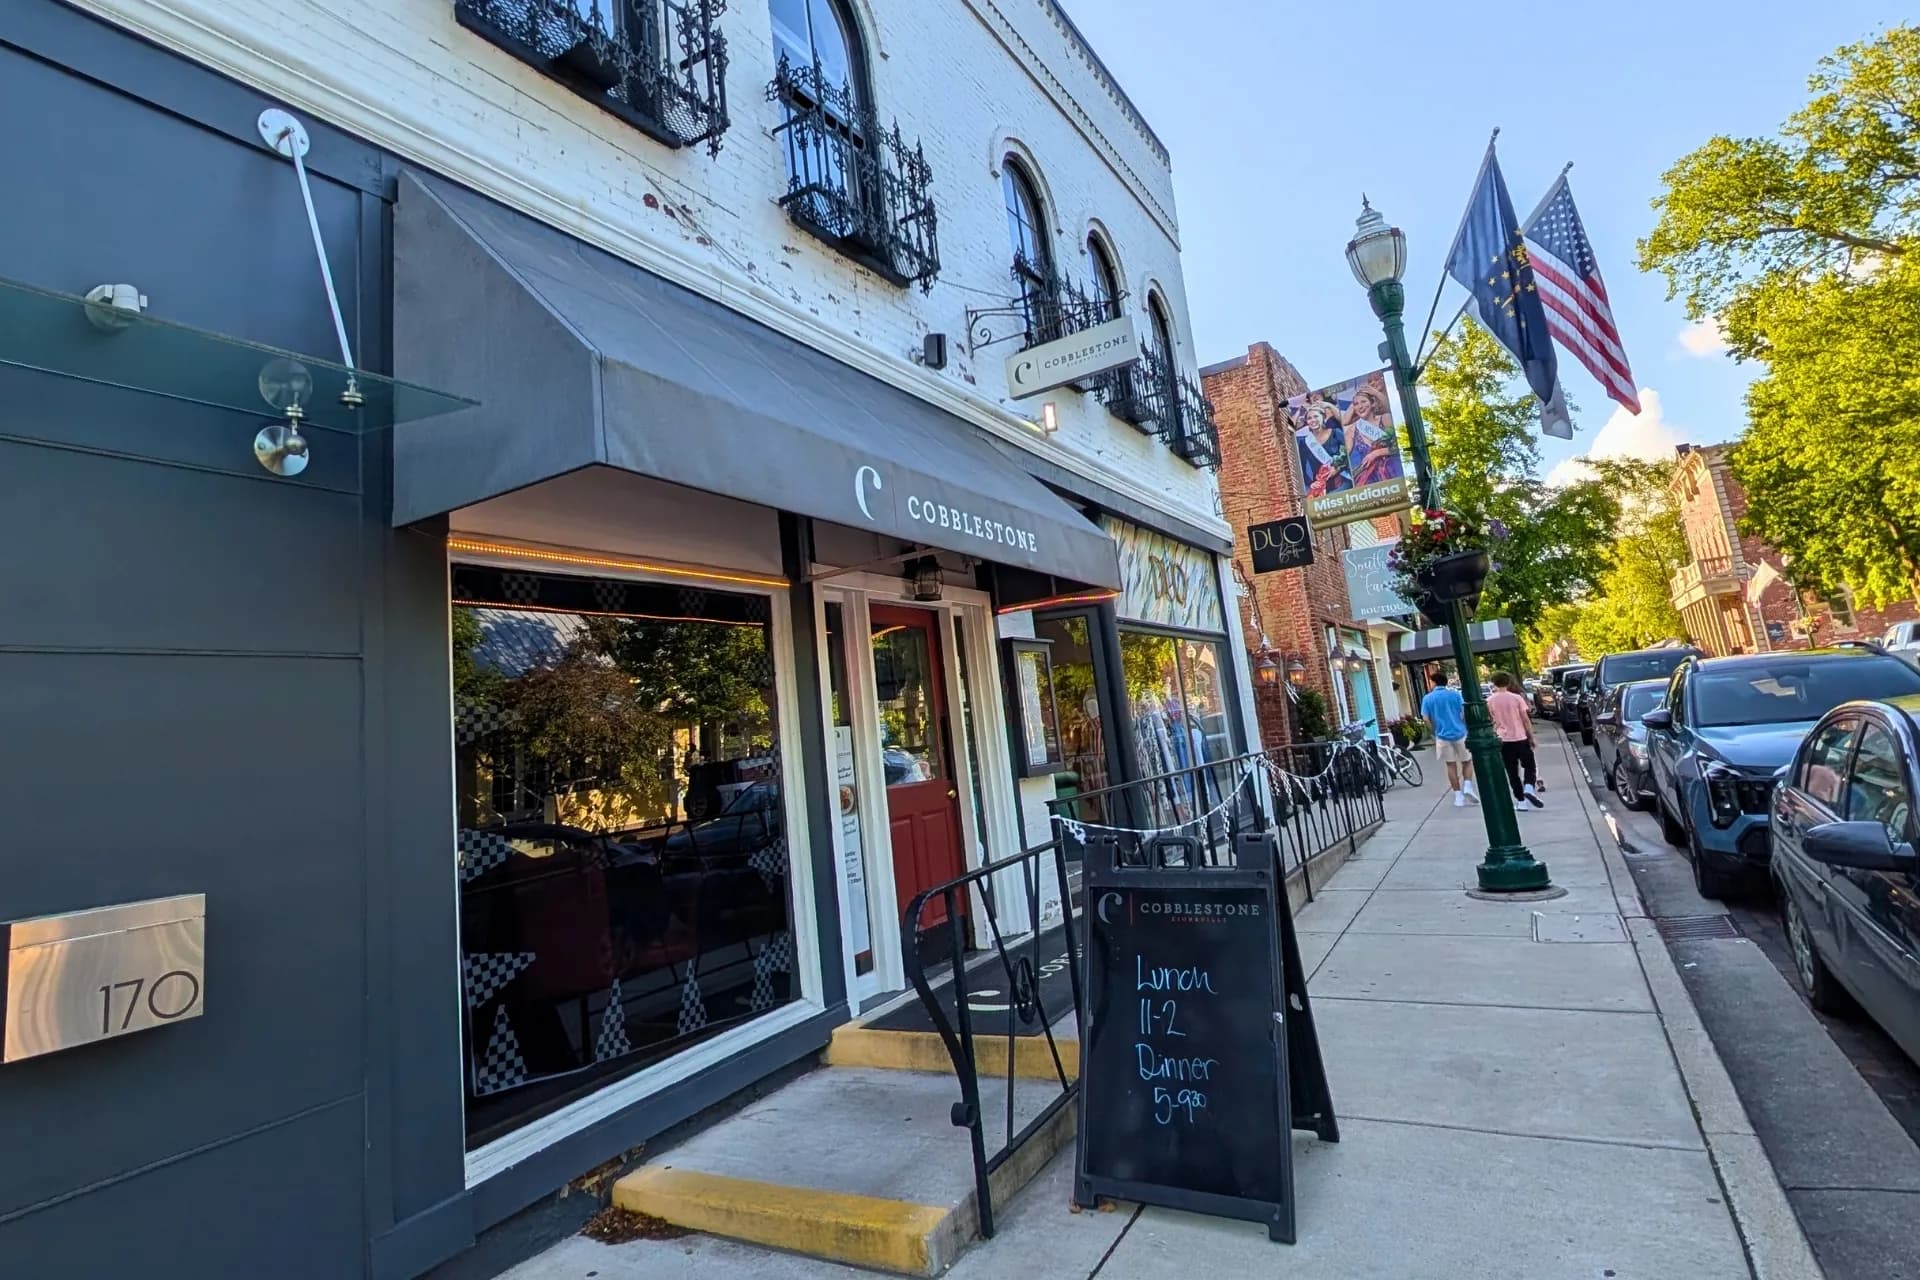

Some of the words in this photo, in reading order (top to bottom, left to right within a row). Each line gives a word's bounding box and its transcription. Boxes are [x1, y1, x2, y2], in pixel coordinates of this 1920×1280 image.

[1044, 334, 1128, 369] COBBLESTONE
[1313, 496, 1344, 512] Miss
[1346, 483, 1401, 505] Indiana
[908, 495, 1038, 553] COBBLESTONE
[1252, 522, 1305, 551] DUO
[1140, 902, 1260, 916] COBBLESTONE
[1137, 955, 1219, 995] Lunch
[99, 970, 199, 1034] 170
[1141, 998, 1187, 1037] 11-2
[1135, 1042, 1220, 1081] Dinner
